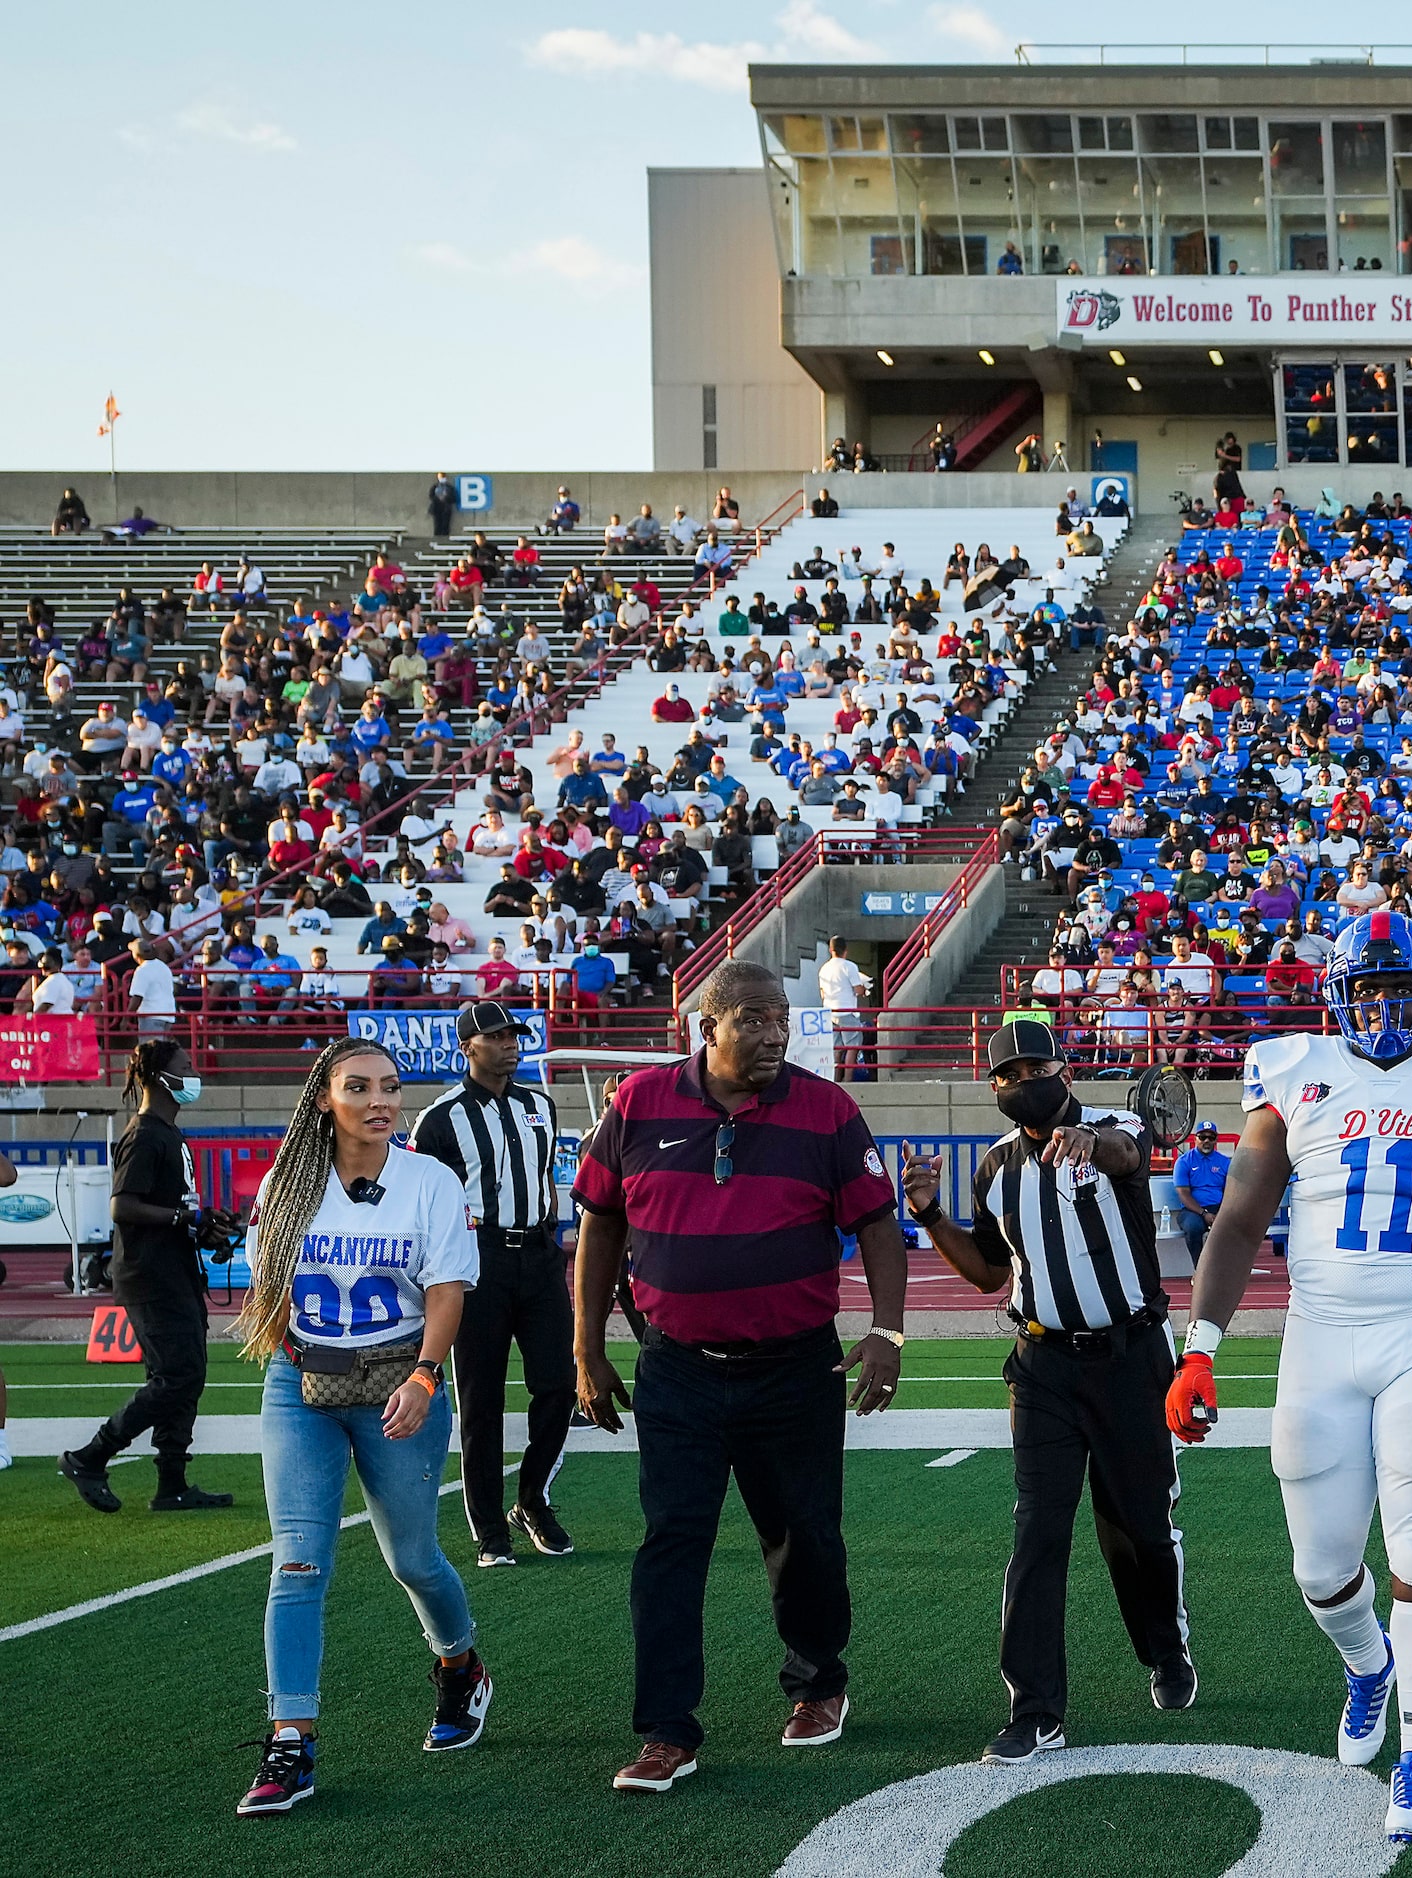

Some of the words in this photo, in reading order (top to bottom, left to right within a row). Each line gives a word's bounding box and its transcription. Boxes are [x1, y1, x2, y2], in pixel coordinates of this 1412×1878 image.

[1134, 296, 1232, 321] Welcome
[1249, 295, 1272, 321] To
[1289, 295, 1375, 321] Panther
[460, 476, 486, 509] B
[1336, 717, 1353, 726] TCU
[901, 899, 915, 914] C
[1020, 955, 1026, 965] 7
[993, 994, 1001, 1005] 5
[980, 1014, 988, 1025] 4
[357, 1015, 546, 1051] PANTS
[301, 1233, 413, 1270] NCANVILLE
[94, 1311, 138, 1353] 40
